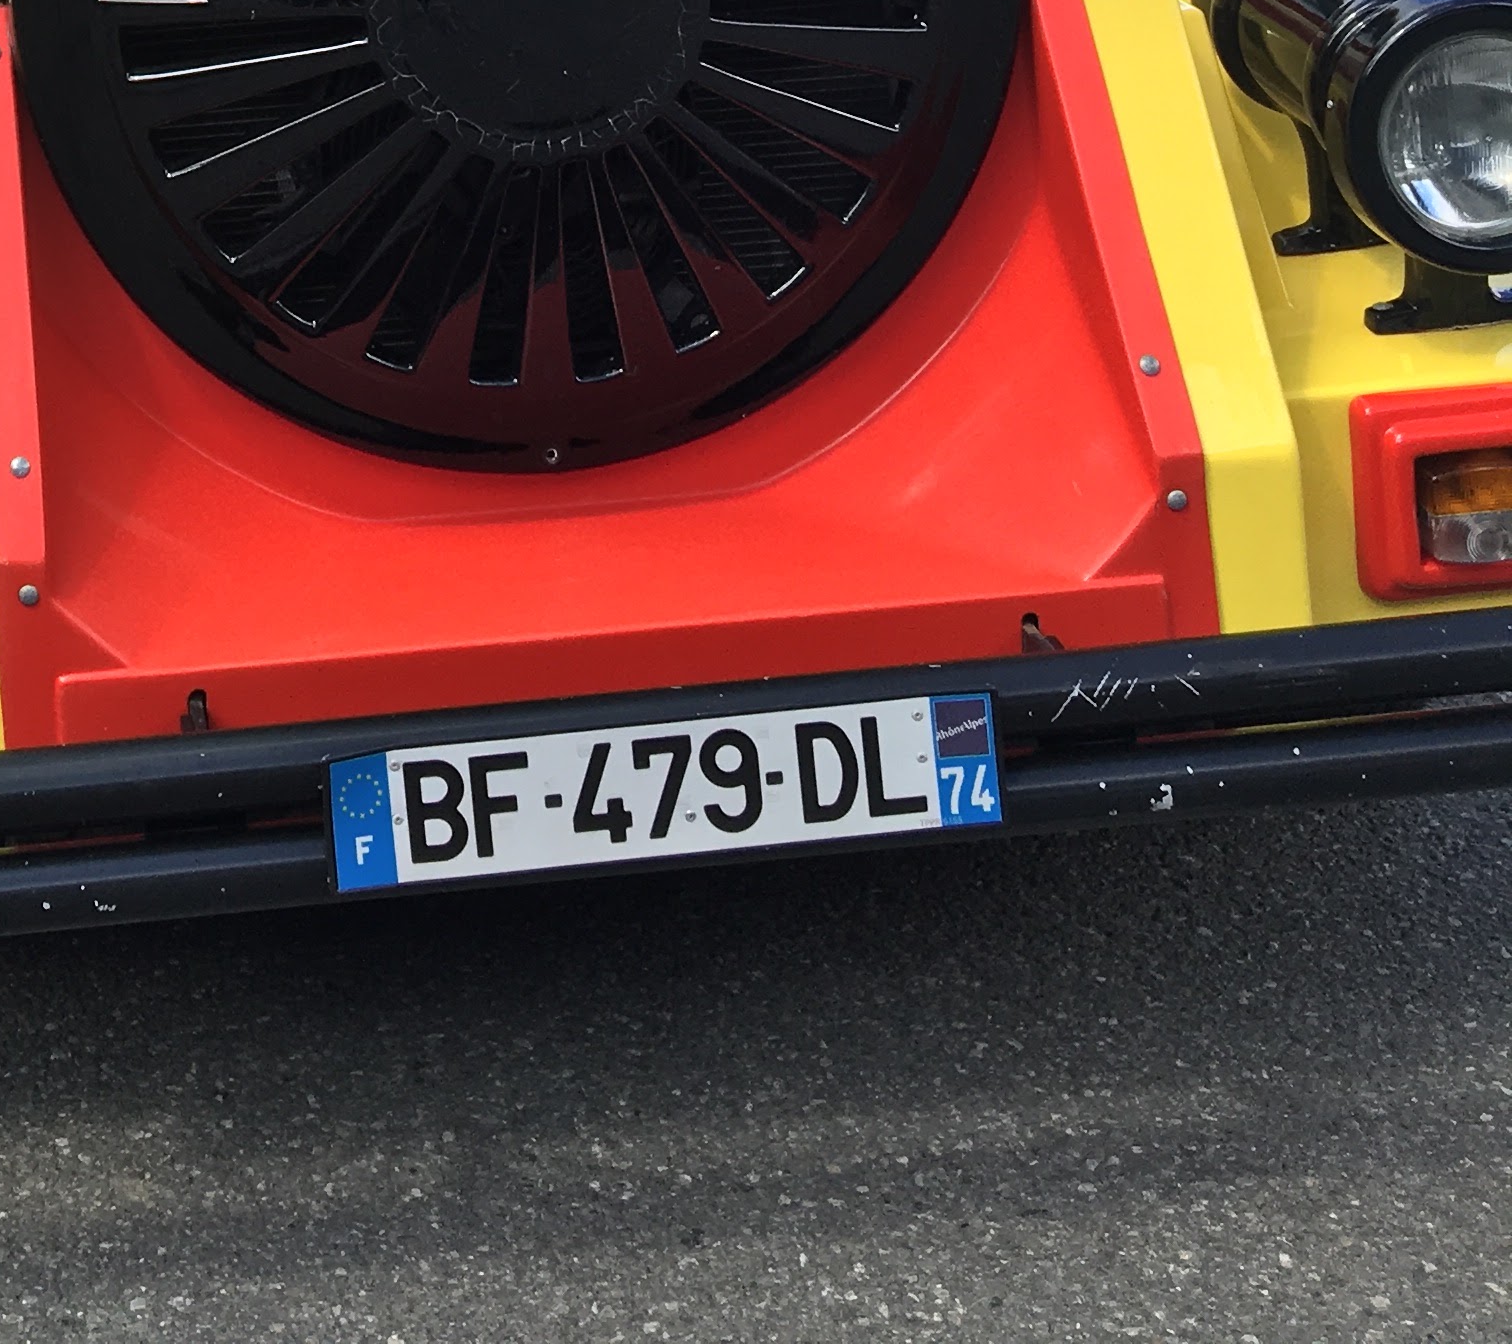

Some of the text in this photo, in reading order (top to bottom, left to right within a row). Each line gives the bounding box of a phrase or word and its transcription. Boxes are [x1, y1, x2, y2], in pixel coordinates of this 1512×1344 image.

[402, 715, 928, 865] BF-479-DL
[940, 764, 995, 814] 74
[355, 834, 374, 866] F
